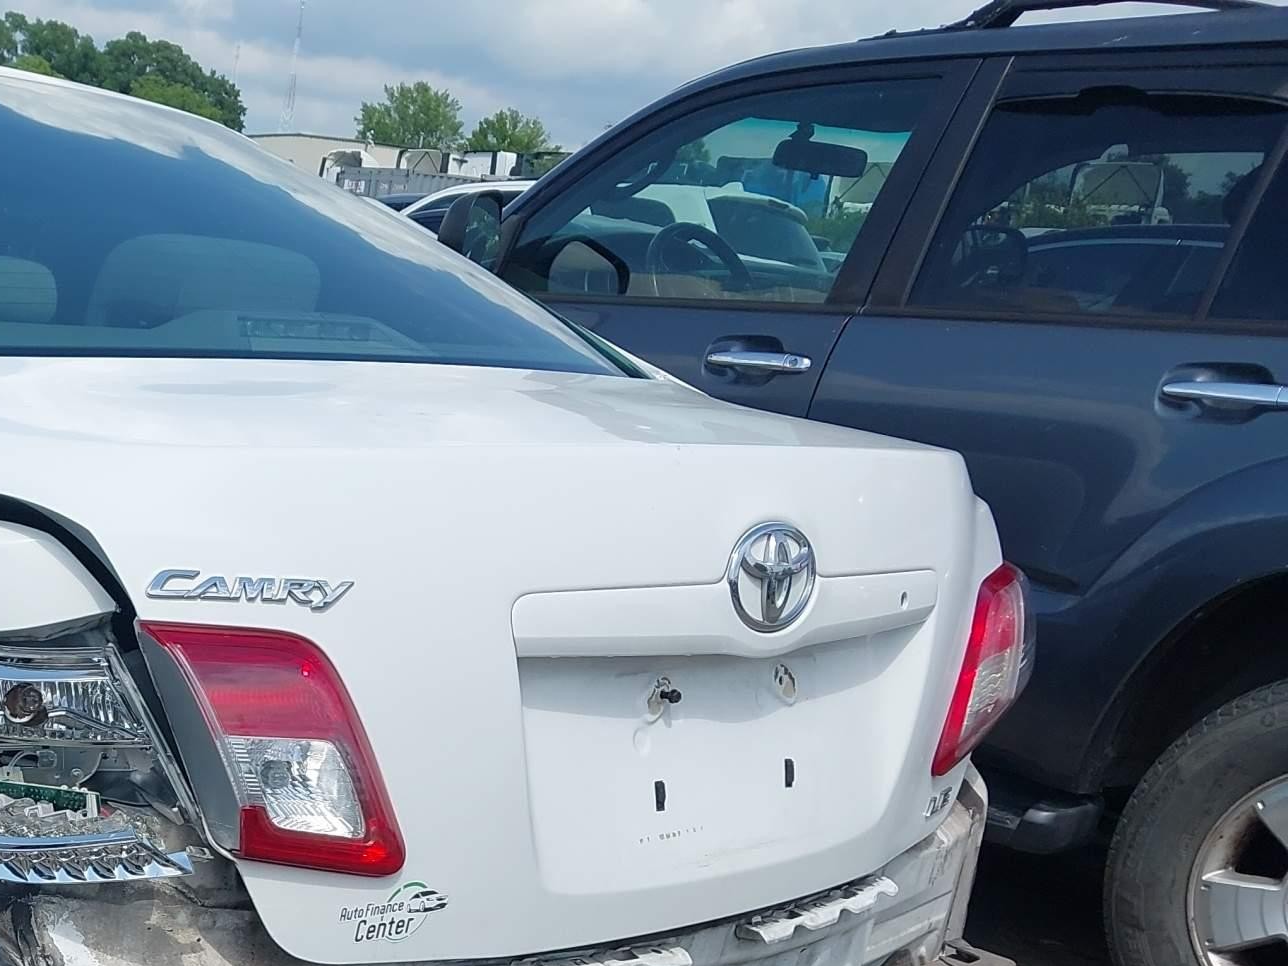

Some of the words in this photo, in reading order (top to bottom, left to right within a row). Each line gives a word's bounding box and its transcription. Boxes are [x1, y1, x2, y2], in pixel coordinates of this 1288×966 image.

[145, 568, 355, 612] CAMRY
[365, 901, 404, 917] Finance
[355, 917, 414, 942] Center
